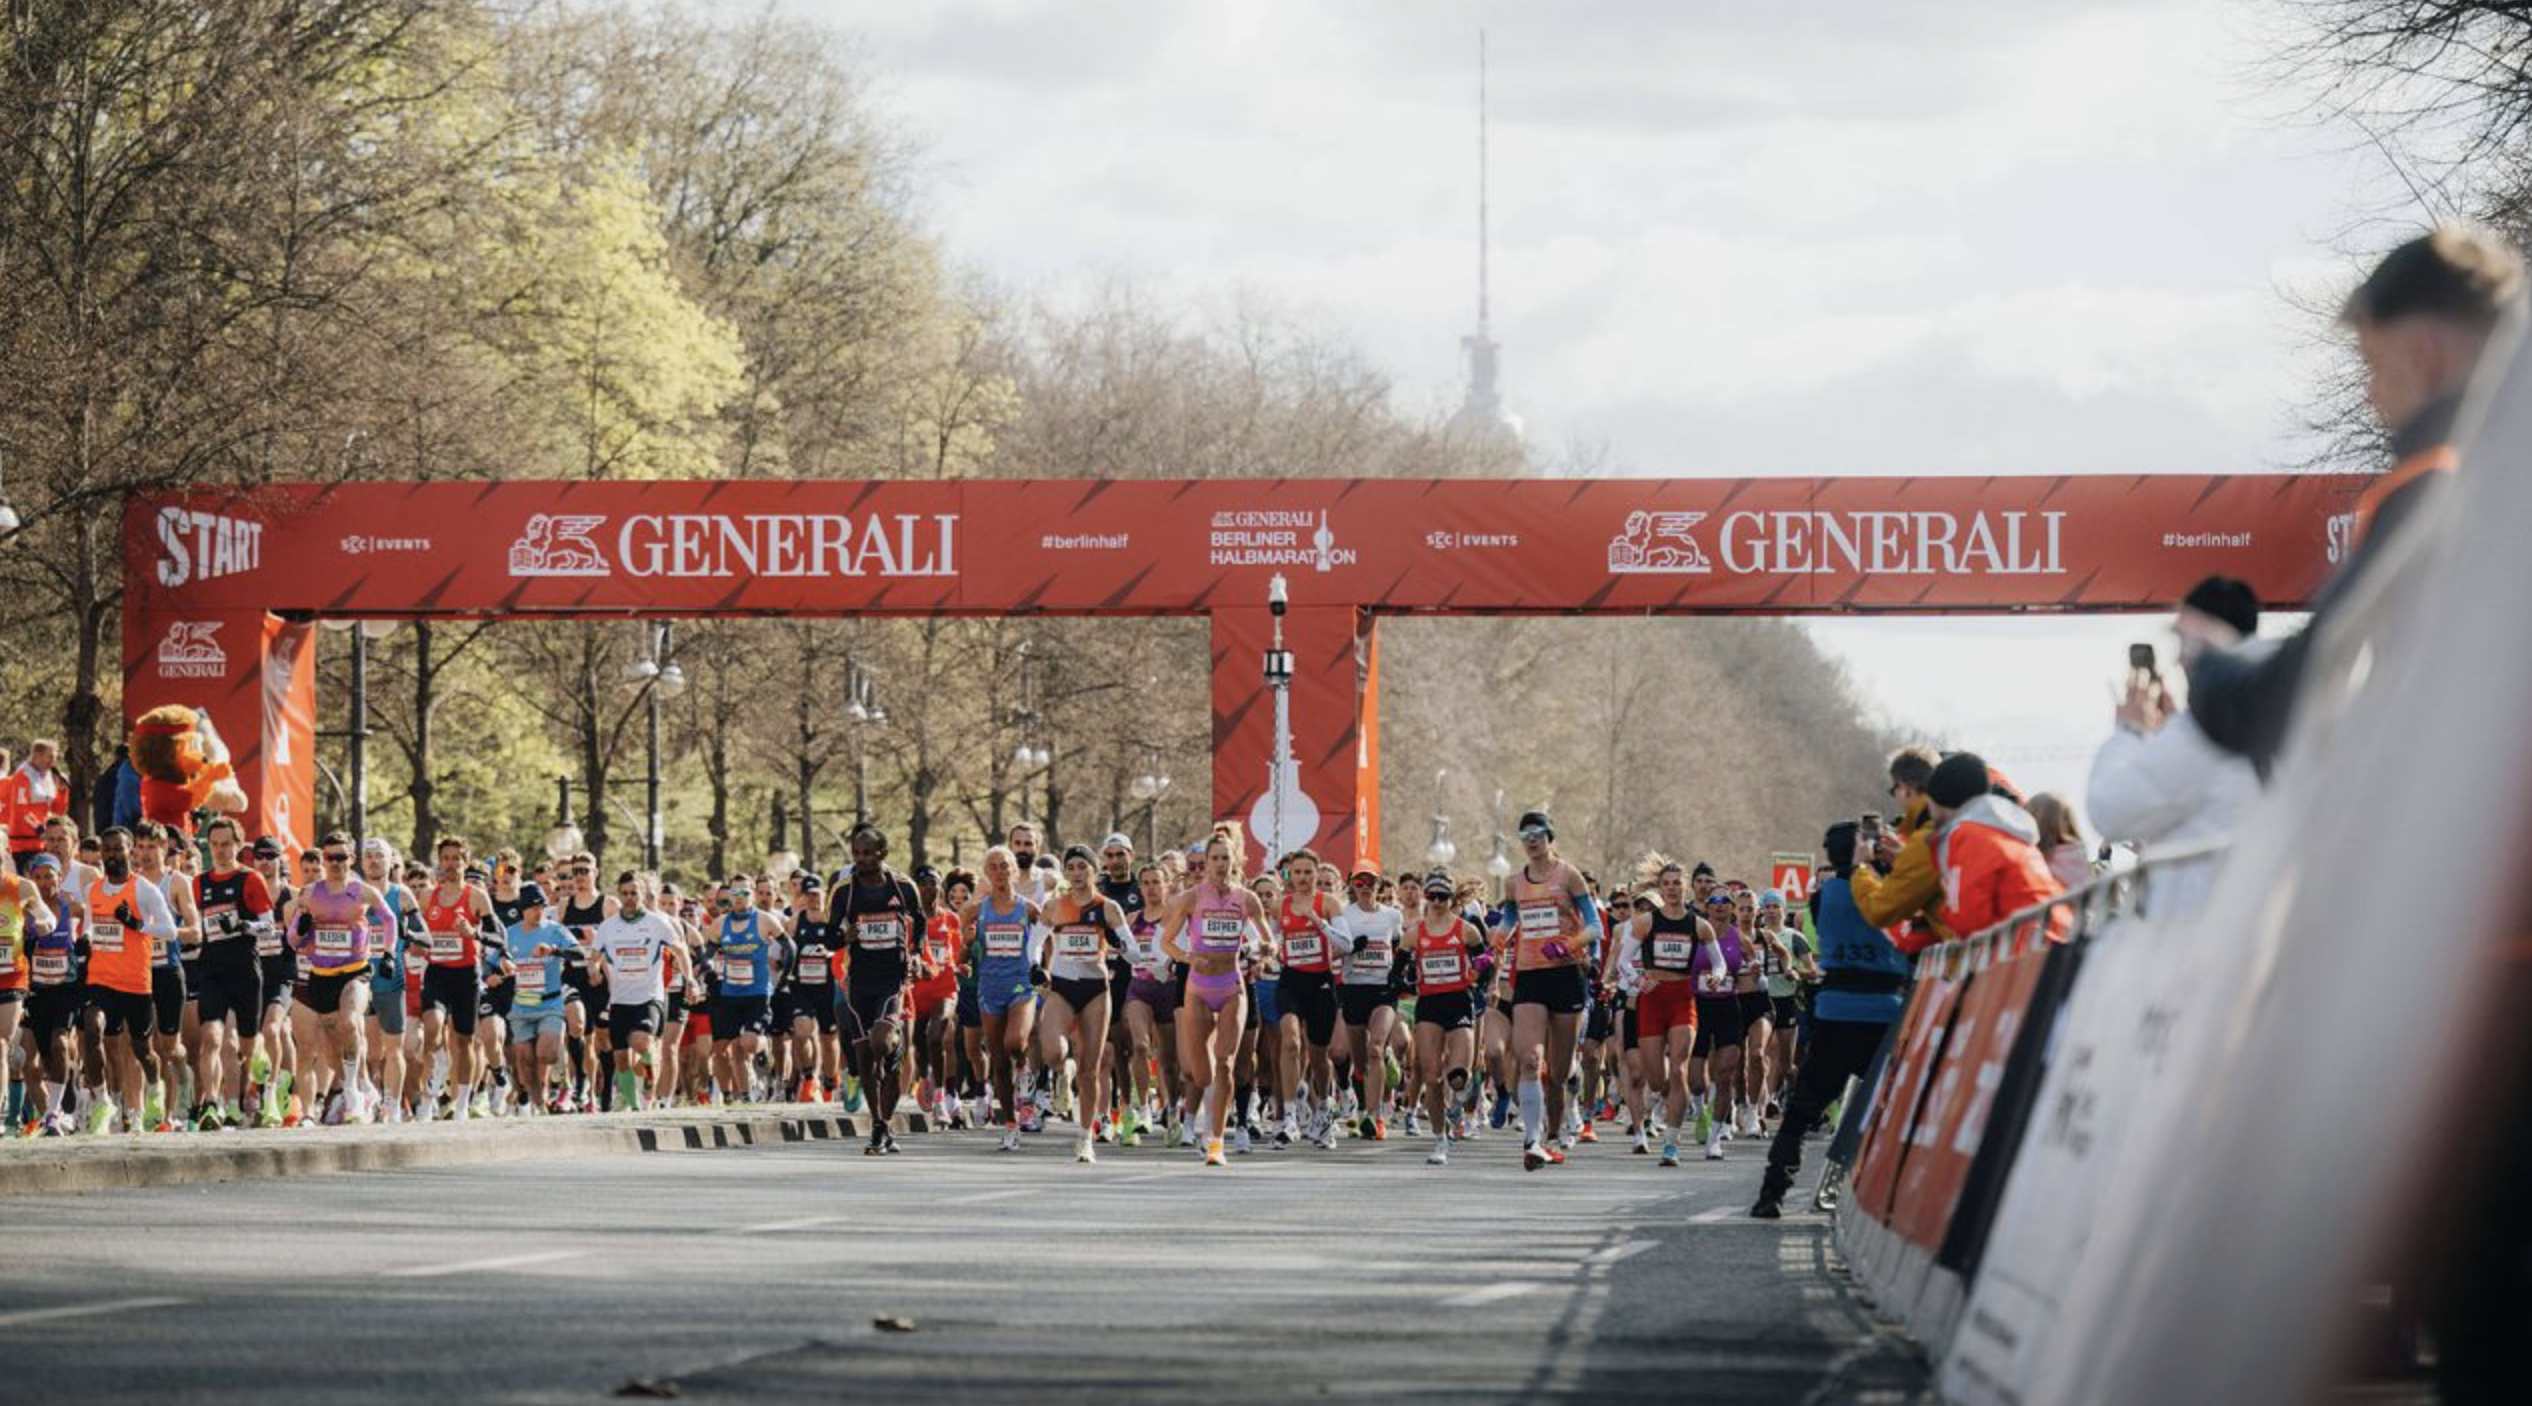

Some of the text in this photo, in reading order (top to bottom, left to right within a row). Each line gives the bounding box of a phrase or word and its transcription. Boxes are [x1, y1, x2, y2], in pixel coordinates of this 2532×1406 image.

[1235, 511, 1313, 527] GENERALI
[157, 506, 262, 587] START
[376, 538, 430, 550] EVENTS
[618, 512, 960, 577] GENERALI
[1041, 534, 1129, 549] #berlinhalf
[1211, 531, 1296, 547] BERLINER
[1463, 536, 1518, 547] EVENTS
[1719, 510, 2067, 574] GENERALI
[2162, 532, 2252, 547] #berlinhalf
[159, 663, 226, 678] GENERALI
[1781, 867, 1804, 899] A
[867, 923, 888, 935] PACE
[1207, 920, 1238, 932] ESTHER
[1069, 935, 1091, 947] GESA
